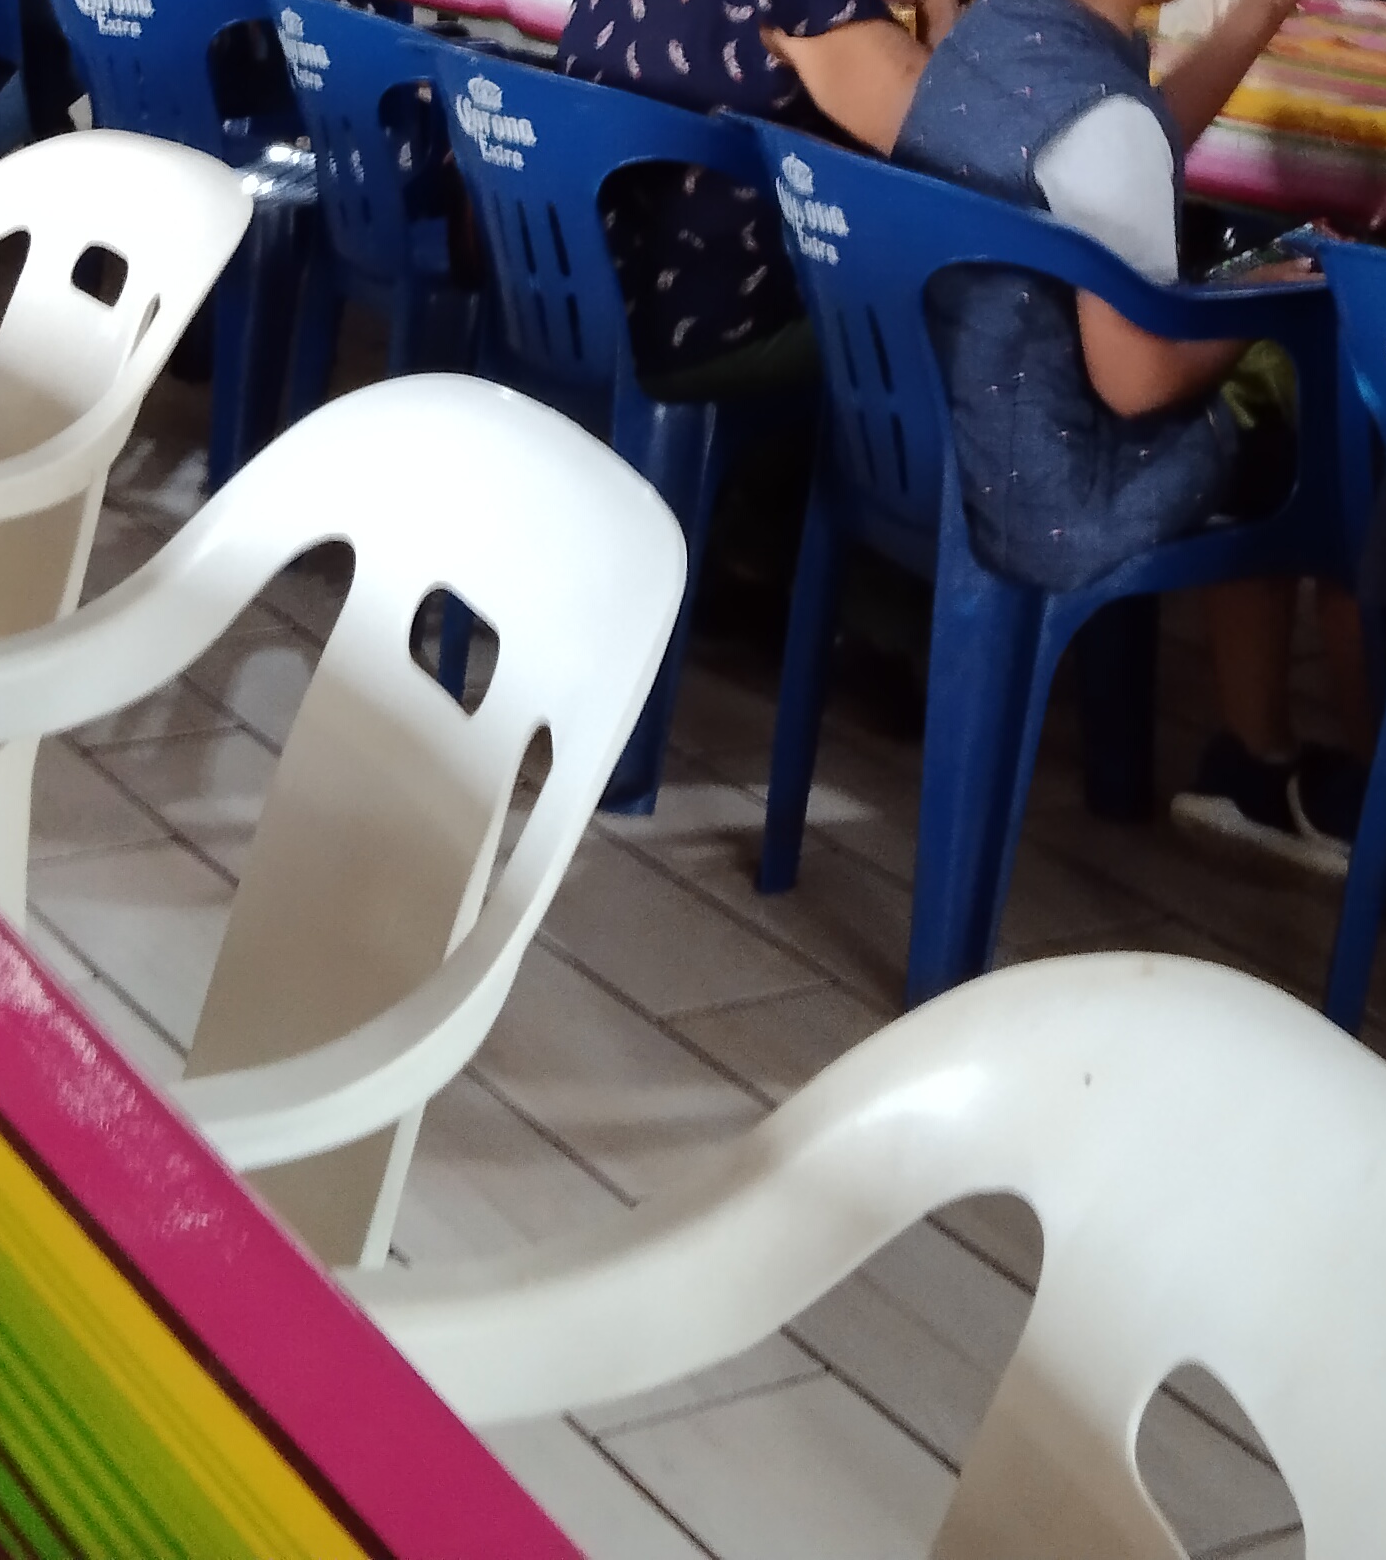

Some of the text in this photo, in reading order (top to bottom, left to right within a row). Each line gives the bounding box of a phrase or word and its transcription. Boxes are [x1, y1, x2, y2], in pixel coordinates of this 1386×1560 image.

[456, 93, 538, 147] Corona
[478, 131, 525, 172] Extra
[775, 177, 850, 237] Corona
